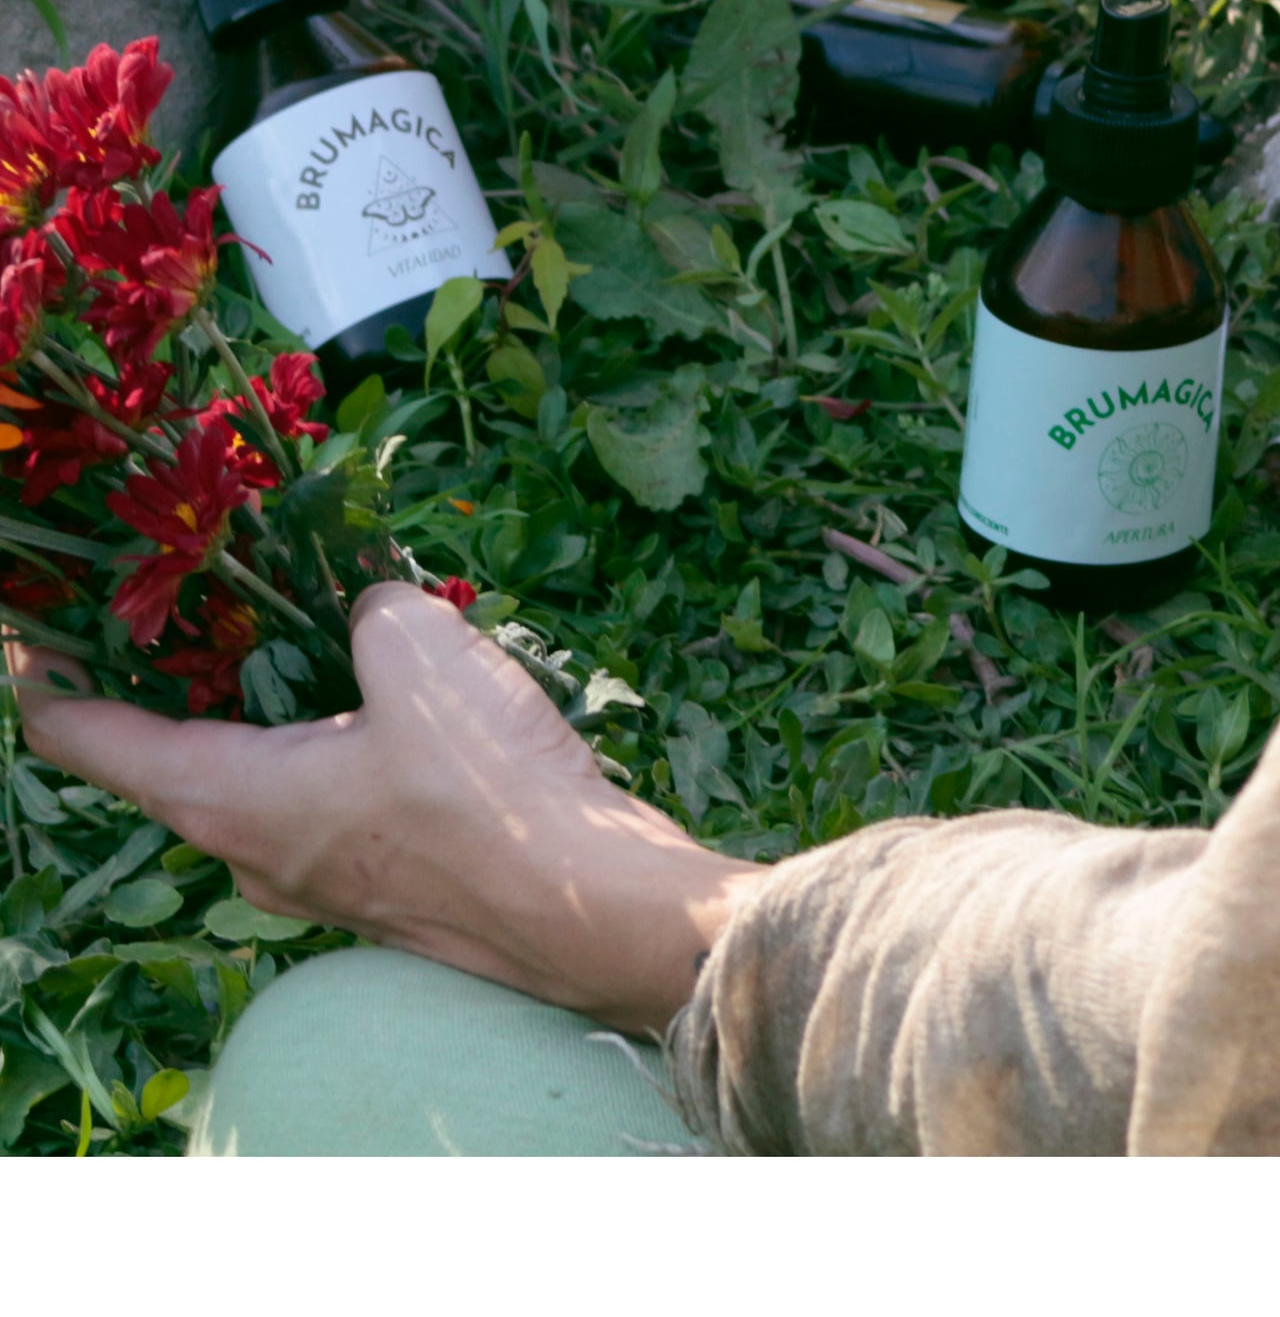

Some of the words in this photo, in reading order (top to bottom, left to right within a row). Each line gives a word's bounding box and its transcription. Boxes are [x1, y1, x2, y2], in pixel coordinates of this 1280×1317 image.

[297, 108, 456, 210] BRUMAGICA
[389, 245, 462, 278] VITALIDAD
[1048, 378, 1215, 451] BRUMAGICA
[1104, 522, 1176, 545] APERTURA
